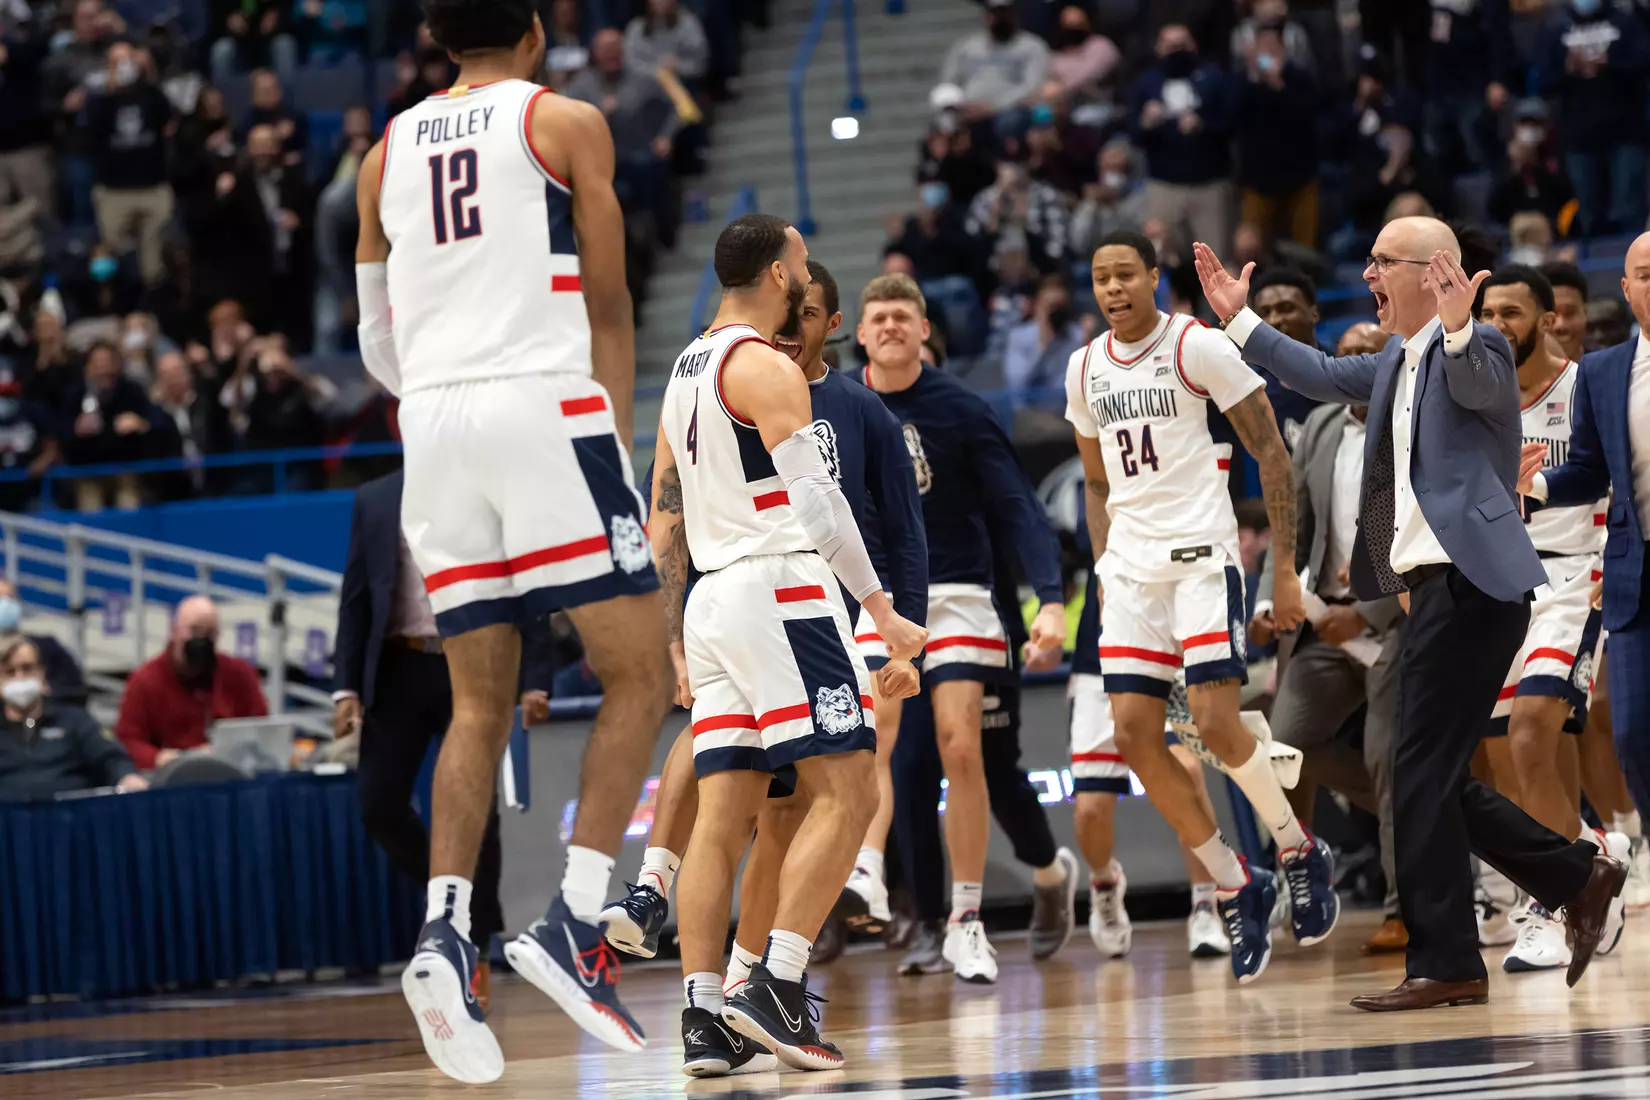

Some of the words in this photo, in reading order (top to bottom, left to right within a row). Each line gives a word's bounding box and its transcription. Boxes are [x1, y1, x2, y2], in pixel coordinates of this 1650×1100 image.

[416, 105, 495, 146] POLLEY
[428, 148, 483, 245] 12
[686, 386, 699, 465] 4
[1090, 388, 1178, 429] CONNECTICUT
[1116, 424, 1159, 477] 24
